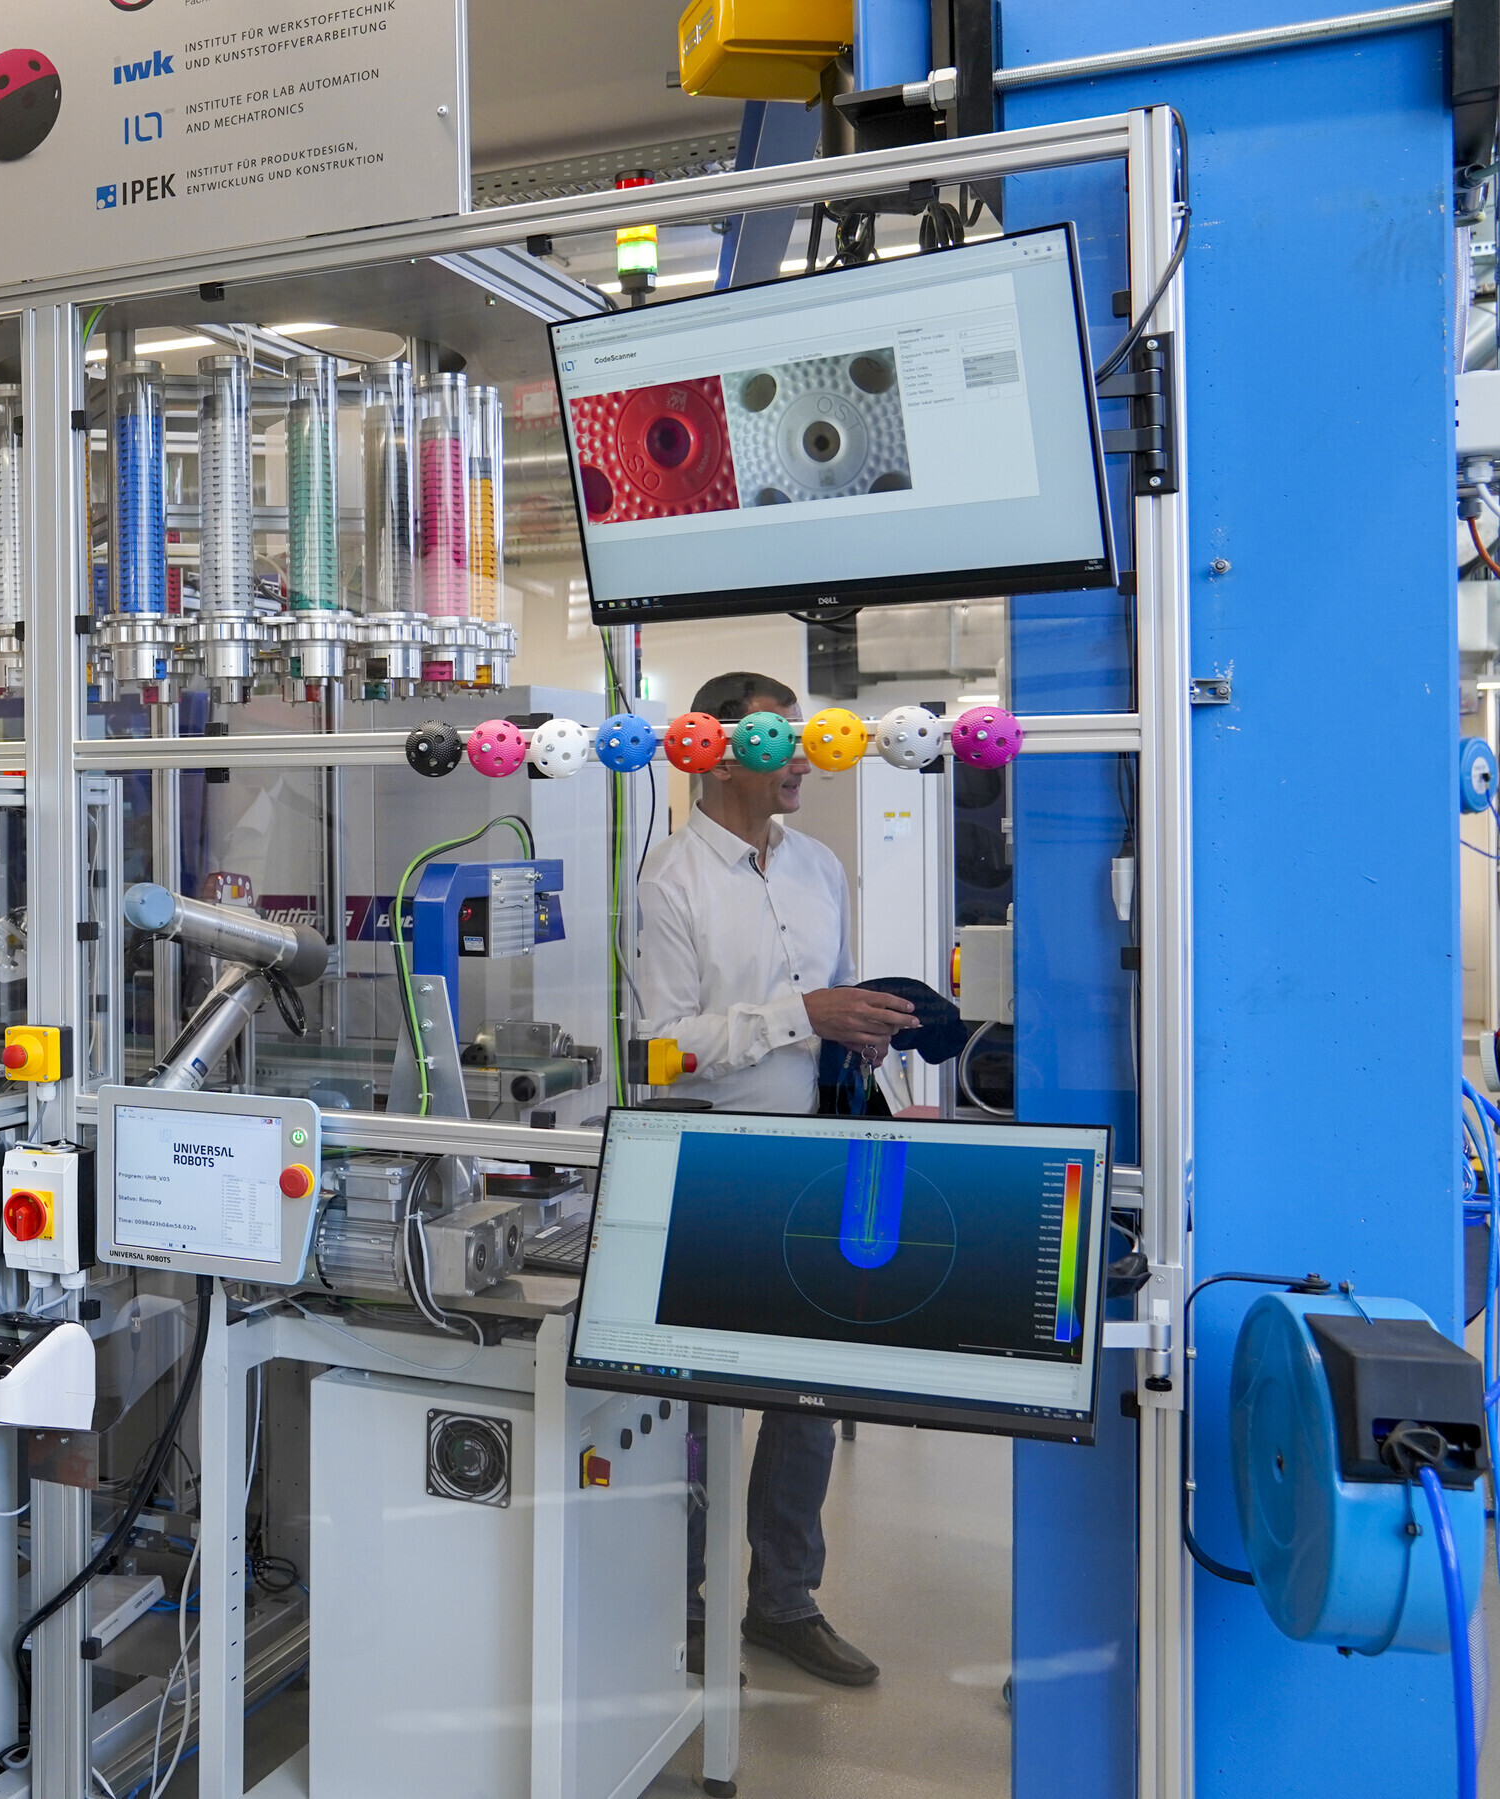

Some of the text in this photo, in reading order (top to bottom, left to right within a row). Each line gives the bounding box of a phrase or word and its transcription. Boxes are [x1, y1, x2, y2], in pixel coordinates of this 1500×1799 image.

[184, 0, 396, 53] INSTITUT FÜR WERKSTOFFTECHNIK
[185, 20, 387, 70] UND KUNSTSTOFFVERARBEITUNG
[112, 50, 175, 85] iwk
[185, 68, 380, 115] INSTITUTE FOR LAB AUTOMATION
[186, 102, 305, 134] AND MECHATRONICS
[186, 141, 358, 179] INSTITUT FÜR PRODUKTDESIGN,
[186, 153, 385, 196] ENTWICKLUNG UND KONSTRUKTION
[122, 173, 176, 206] IPEK
[593, 351, 637, 365] CodeScanner
[817, 596, 839, 605] DELL
[173, 1142, 235, 1158] UNIVERSAL
[173, 1154, 215, 1168] ROBOTS
[118, 1171, 144, 1181] Program:
[118, 1195, 162, 1205] Status: Running
[118, 1217, 134, 1225] Time:
[109, 1249, 171, 1264] UNIVERSAL ROBOTS
[799, 1395, 825, 1407] DELL
